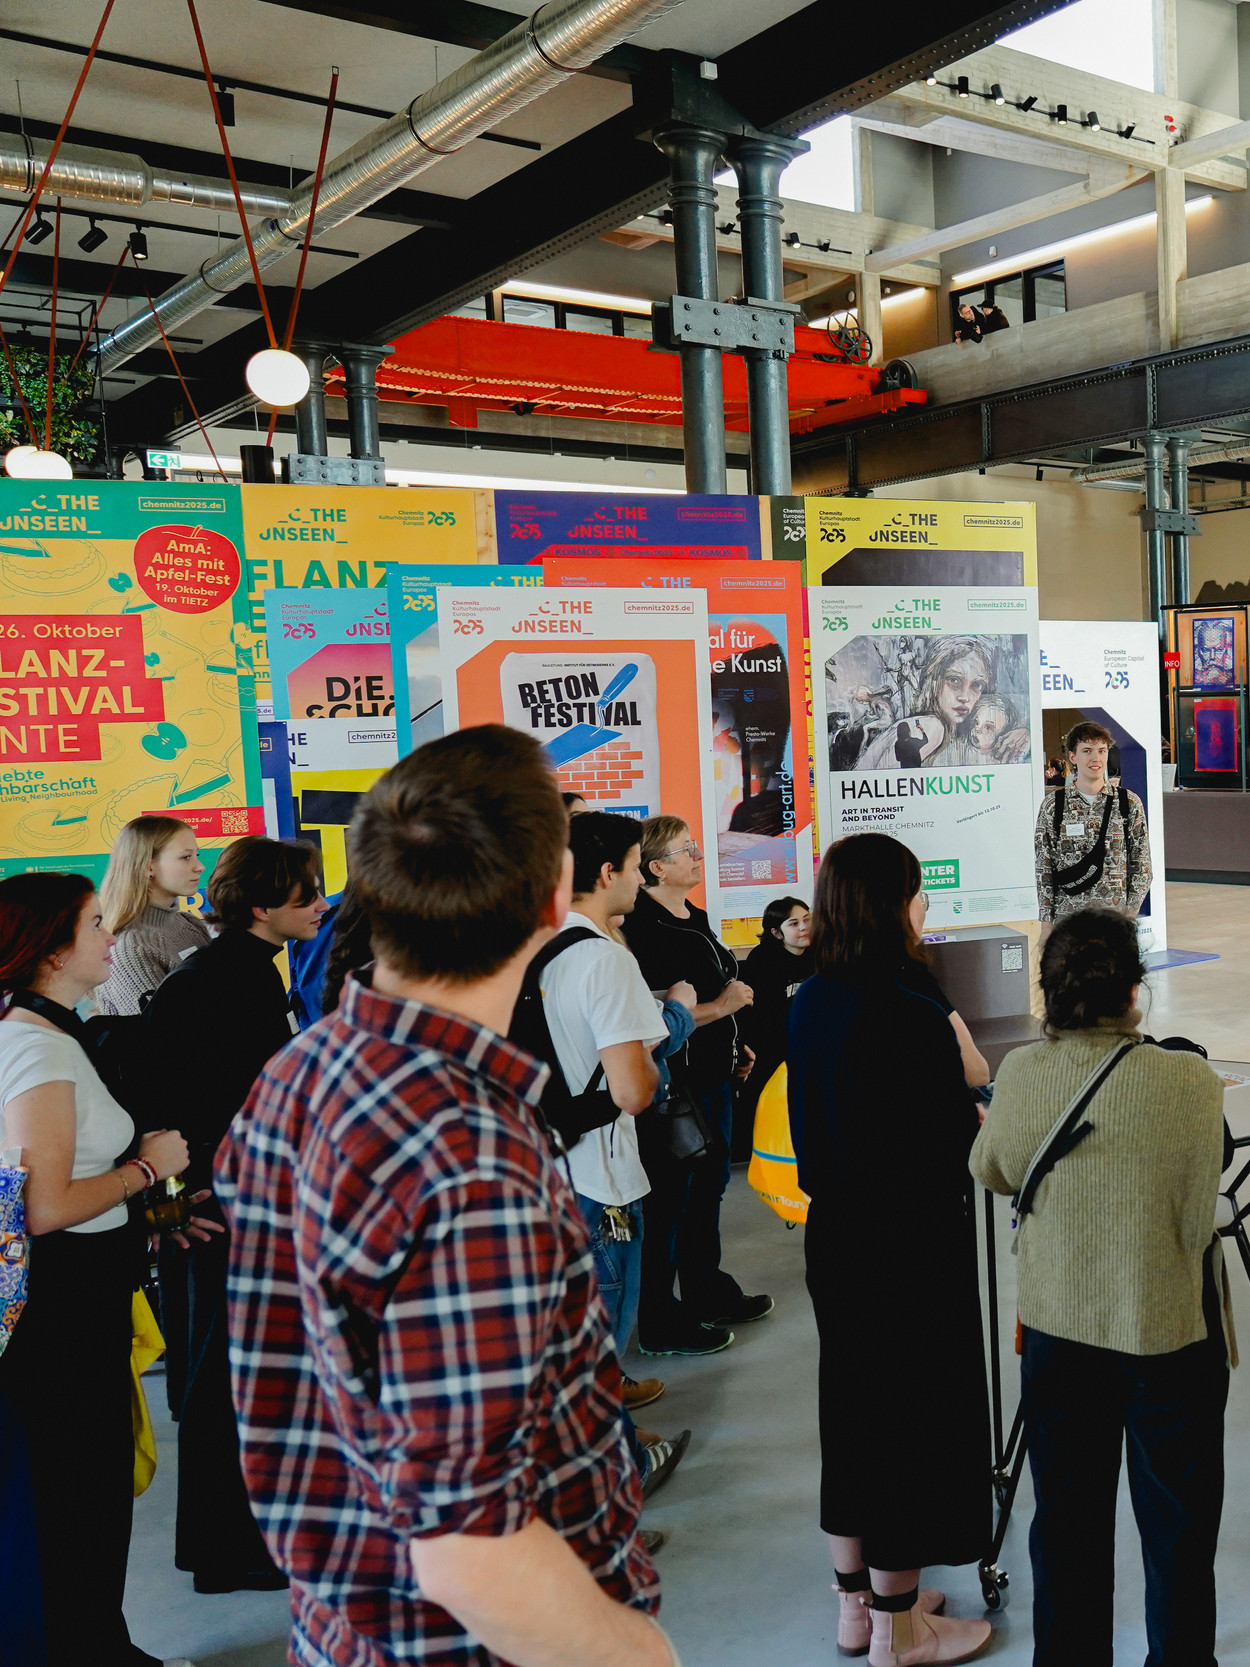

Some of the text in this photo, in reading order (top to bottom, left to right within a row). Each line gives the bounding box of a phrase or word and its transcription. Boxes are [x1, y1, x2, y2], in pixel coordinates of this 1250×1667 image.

[143, 500, 222, 509] chemnitz2025.de
[681, 511, 744, 519] chemnitz2025.de
[966, 518, 1021, 526] chemnitz2025.de
[166, 540, 211, 556] AmA:
[555, 548, 601, 557] KOSMOS
[619, 549, 653, 557] Chemnitz
[689, 549, 733, 557] KOSMOS
[152, 553, 225, 571] Alles mit
[144, 566, 231, 586] Apfel-Fest
[723, 579, 783, 588] chemnitz2025.de
[155, 583, 219, 597] 19. Oktober
[164, 594, 209, 607] im TIETZ
[627, 604, 691, 612] chemnitz2025.de
[33, 623, 124, 638] Oktober
[730, 628, 756, 649] für
[731, 653, 782, 673] Kunst
[1165, 660, 1180, 668] INFO
[518, 671, 600, 709] BETON
[531, 701, 642, 728] FESTIVAL
[351, 732, 396, 741] chemnitz2
[841, 773, 995, 800] HALLENKUNST
[30, 788, 98, 800] Neighbourhood
[871, 806, 905, 814] TRANSIT
[862, 813, 896, 822] BEYOND
[842, 821, 935, 832] MARKTHALLE CHEMNITZ
[923, 877, 956, 885] TICKETS
